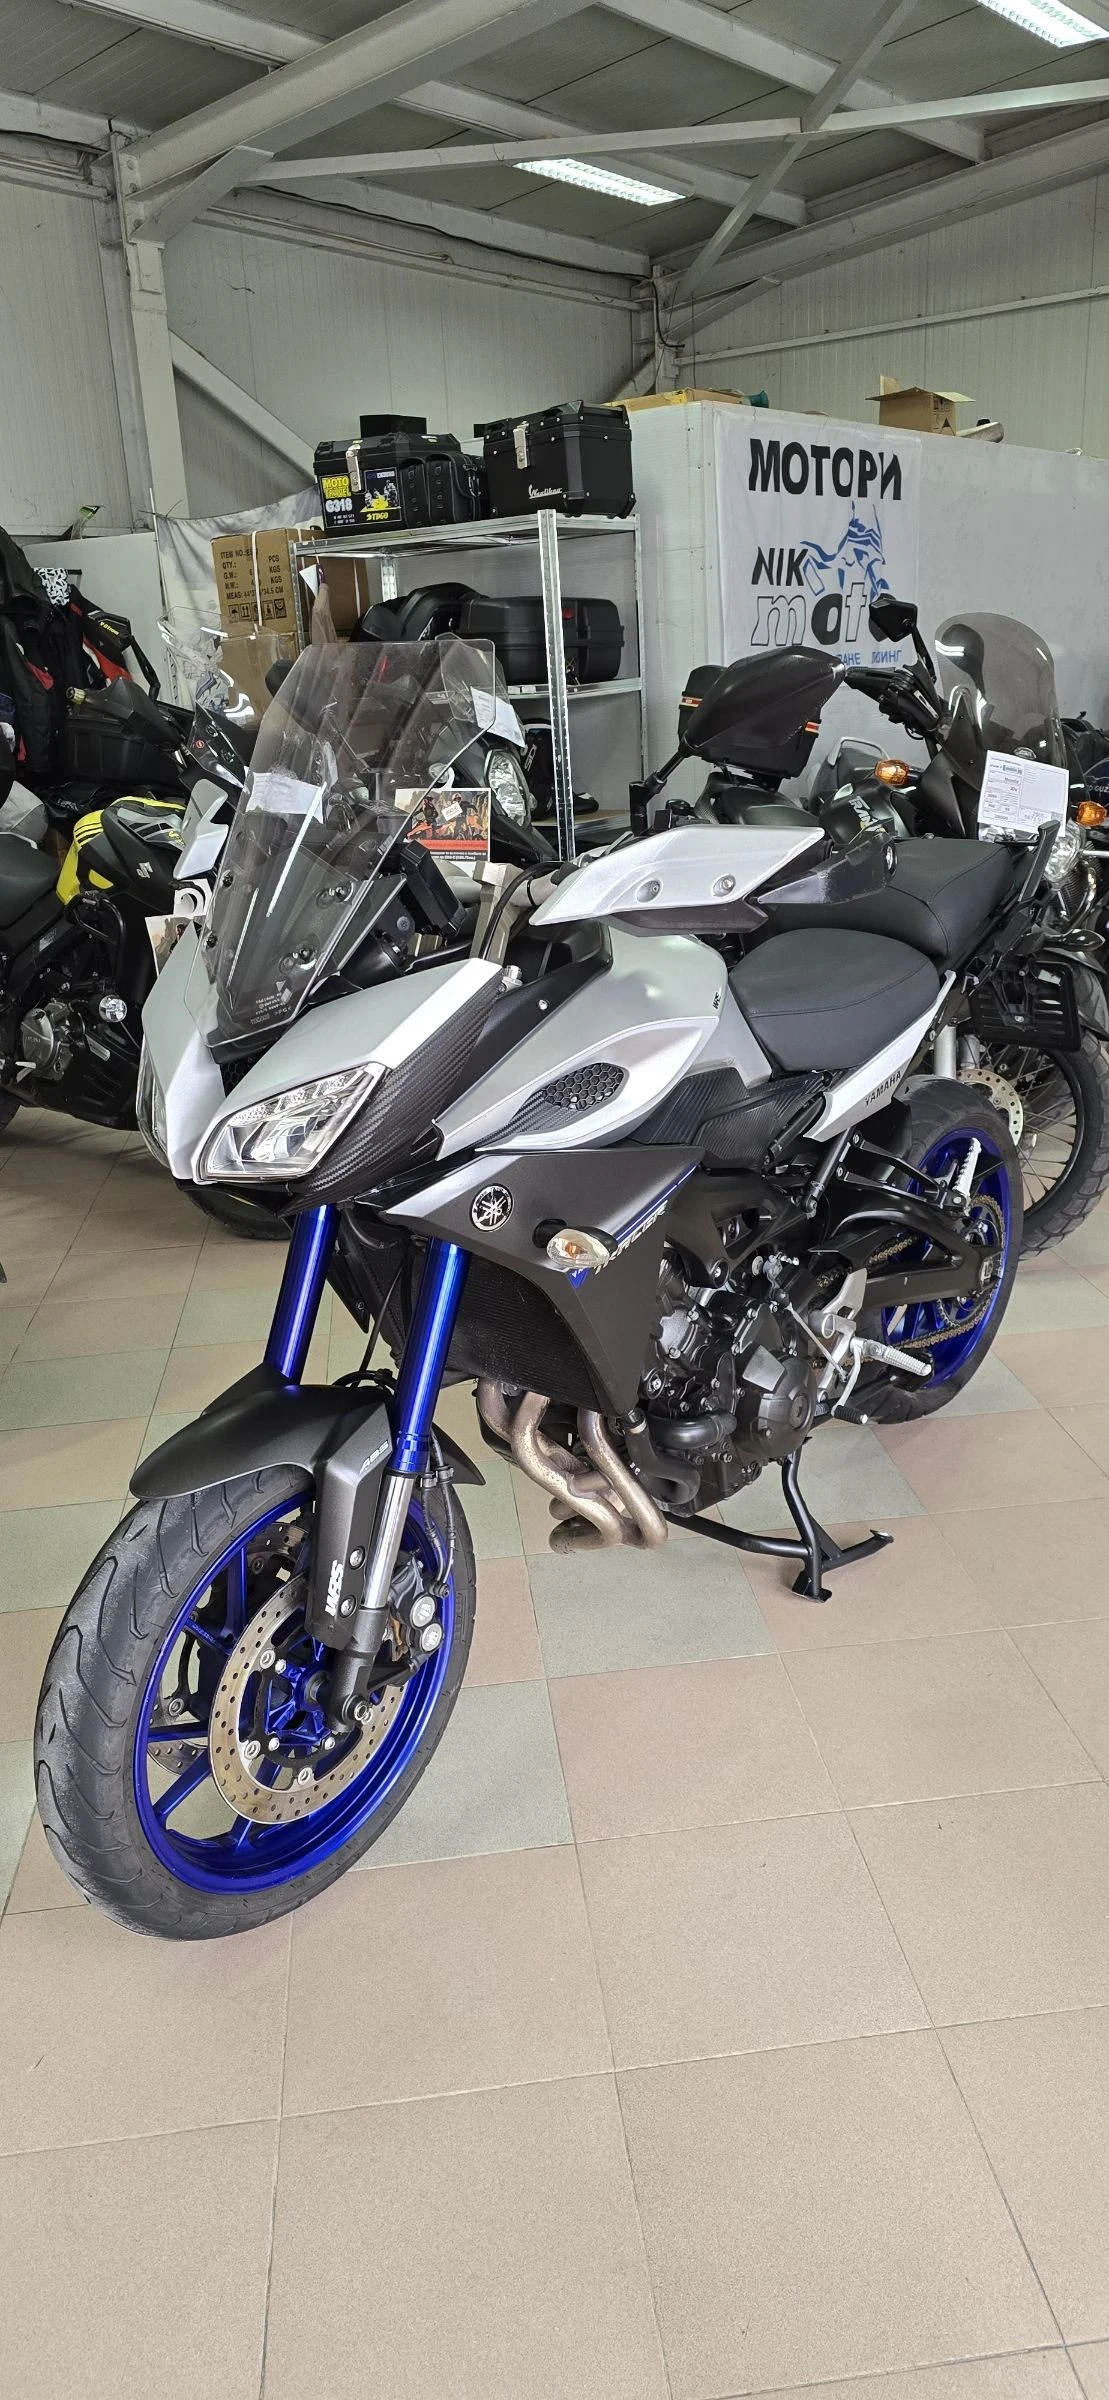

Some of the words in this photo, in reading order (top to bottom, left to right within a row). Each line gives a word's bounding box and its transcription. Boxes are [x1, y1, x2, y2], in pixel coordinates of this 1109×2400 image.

[748, 438, 902, 500] МОТОРИ
[322, 475, 350, 489] MOTO
[325, 498, 353, 513] G318
[220, 550, 234, 560] ITEM
[268, 555, 280, 563] PCS
[269, 565, 281, 574] KGS
[751, 546, 809, 587] NIK
[270, 576, 282, 584] KGS
[275, 586, 284, 594] CM
[865, 1070, 901, 1106] YAMAHA
[359, 1440, 390, 1476] ABS
[325, 1559, 344, 1617] WRS
